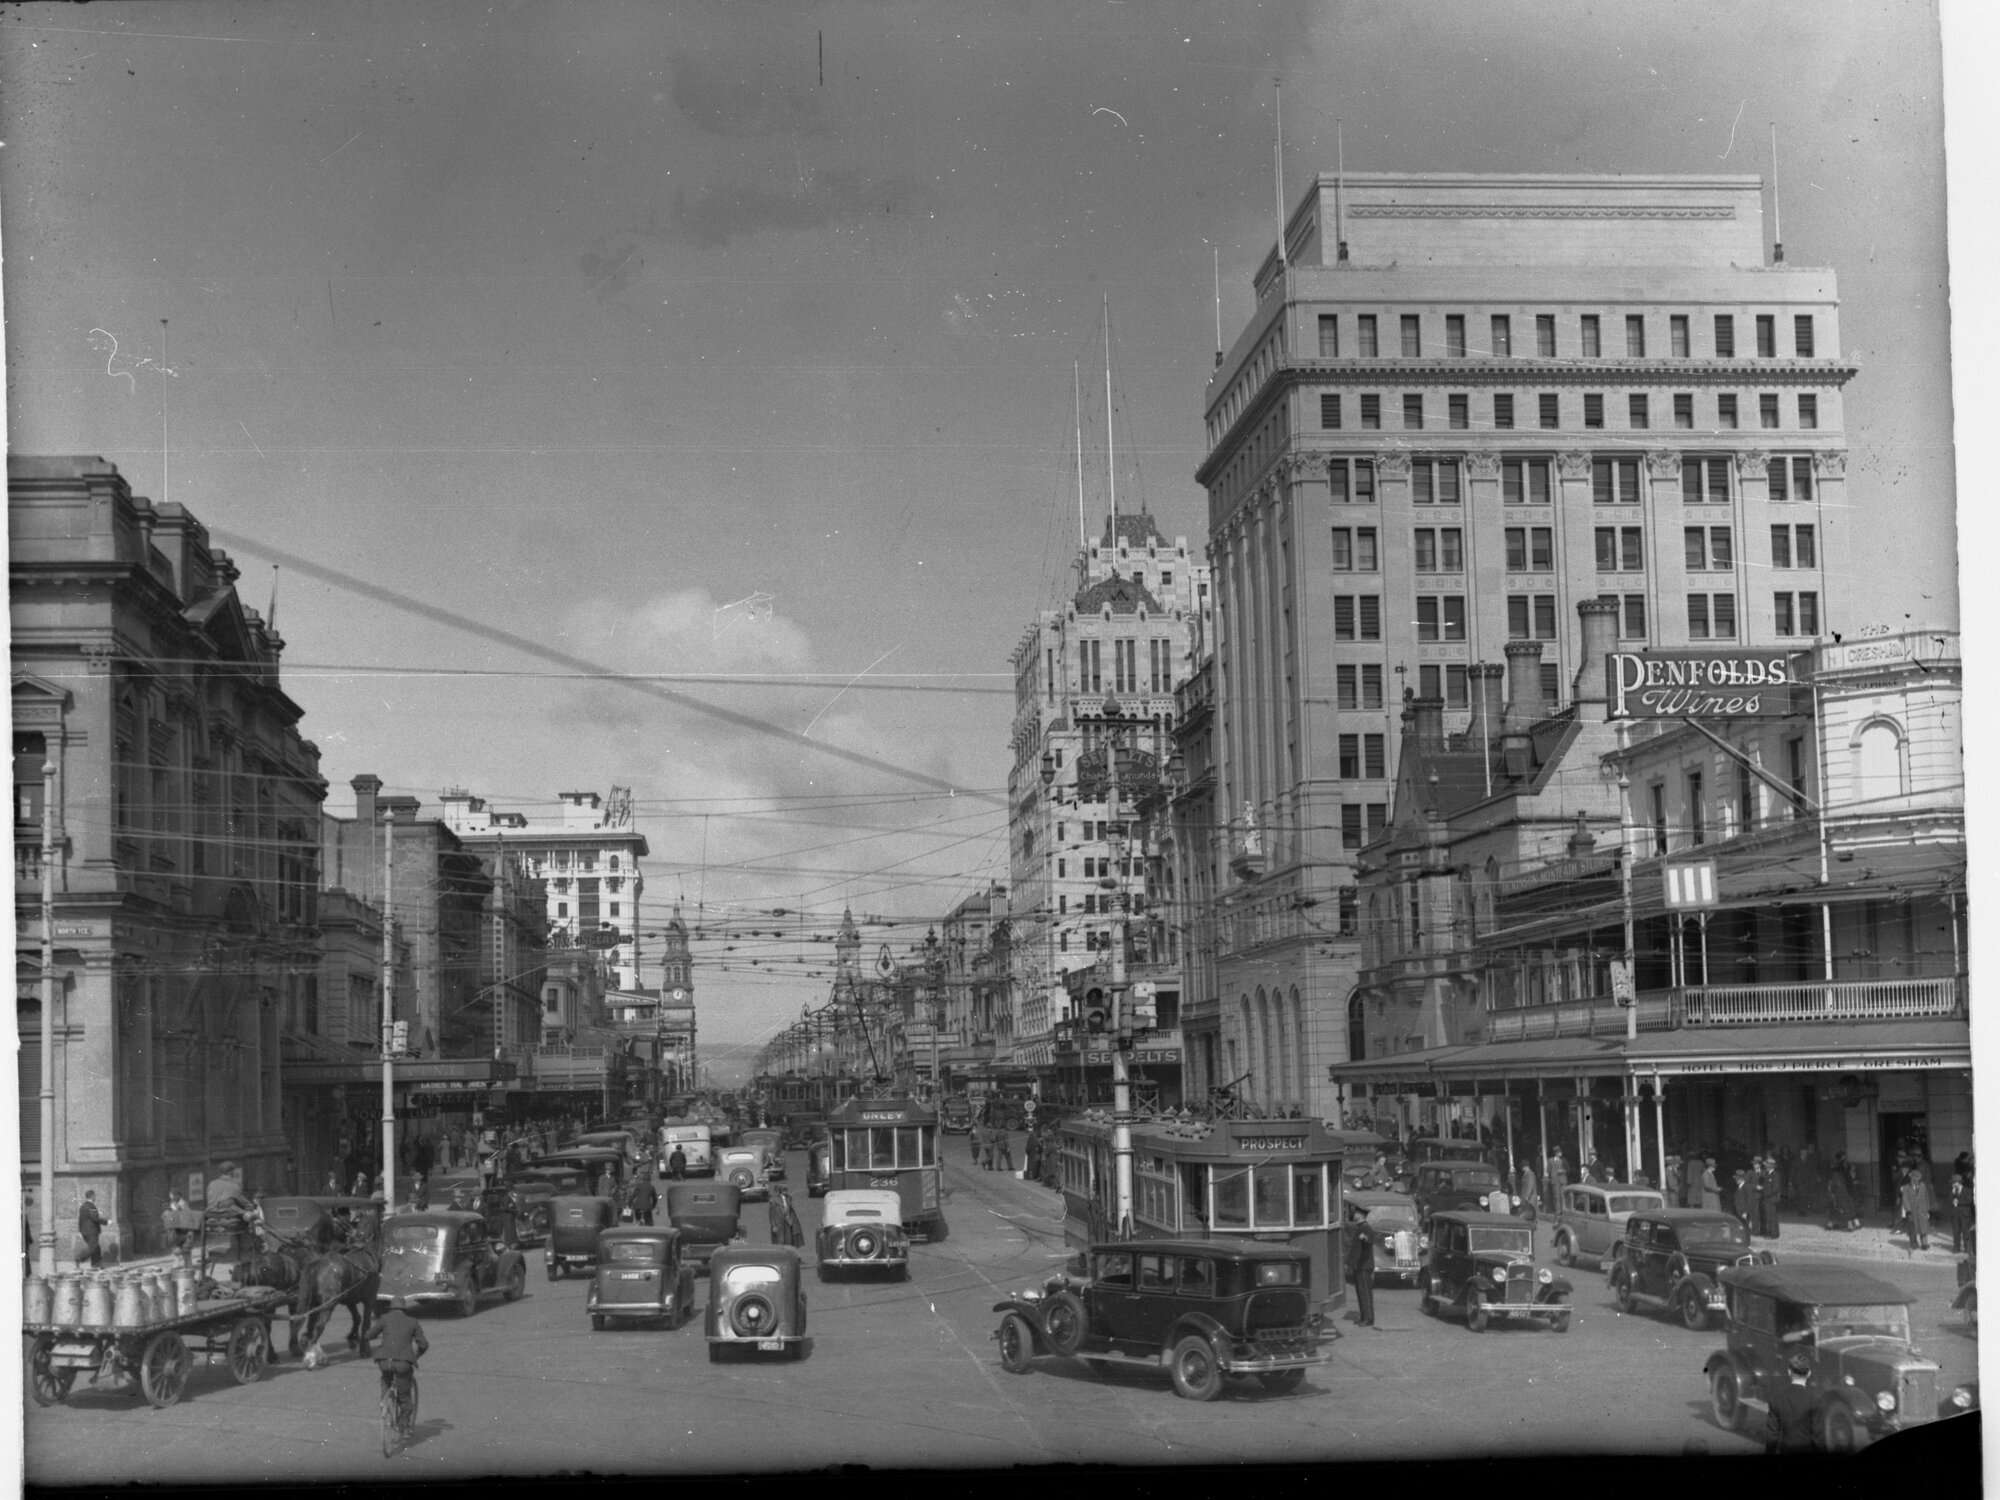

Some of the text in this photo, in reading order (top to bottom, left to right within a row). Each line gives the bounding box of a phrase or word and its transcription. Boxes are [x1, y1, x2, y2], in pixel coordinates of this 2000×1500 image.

[1612, 654, 1786, 716] PENFOLDS
[1641, 690, 1762, 715] Wines
[1087, 1051, 1177, 1064] SEPELTS
[1681, 1063, 1726, 1073] HOTEL
[1791, 1060, 1846, 1070] PIERCE
[1862, 1057, 1942, 1069] GRESHAM
[862, 1111, 903, 1121] UNLEY
[1241, 1137, 1304, 1150] PROSPECT
[870, 1177, 899, 1188] 236
